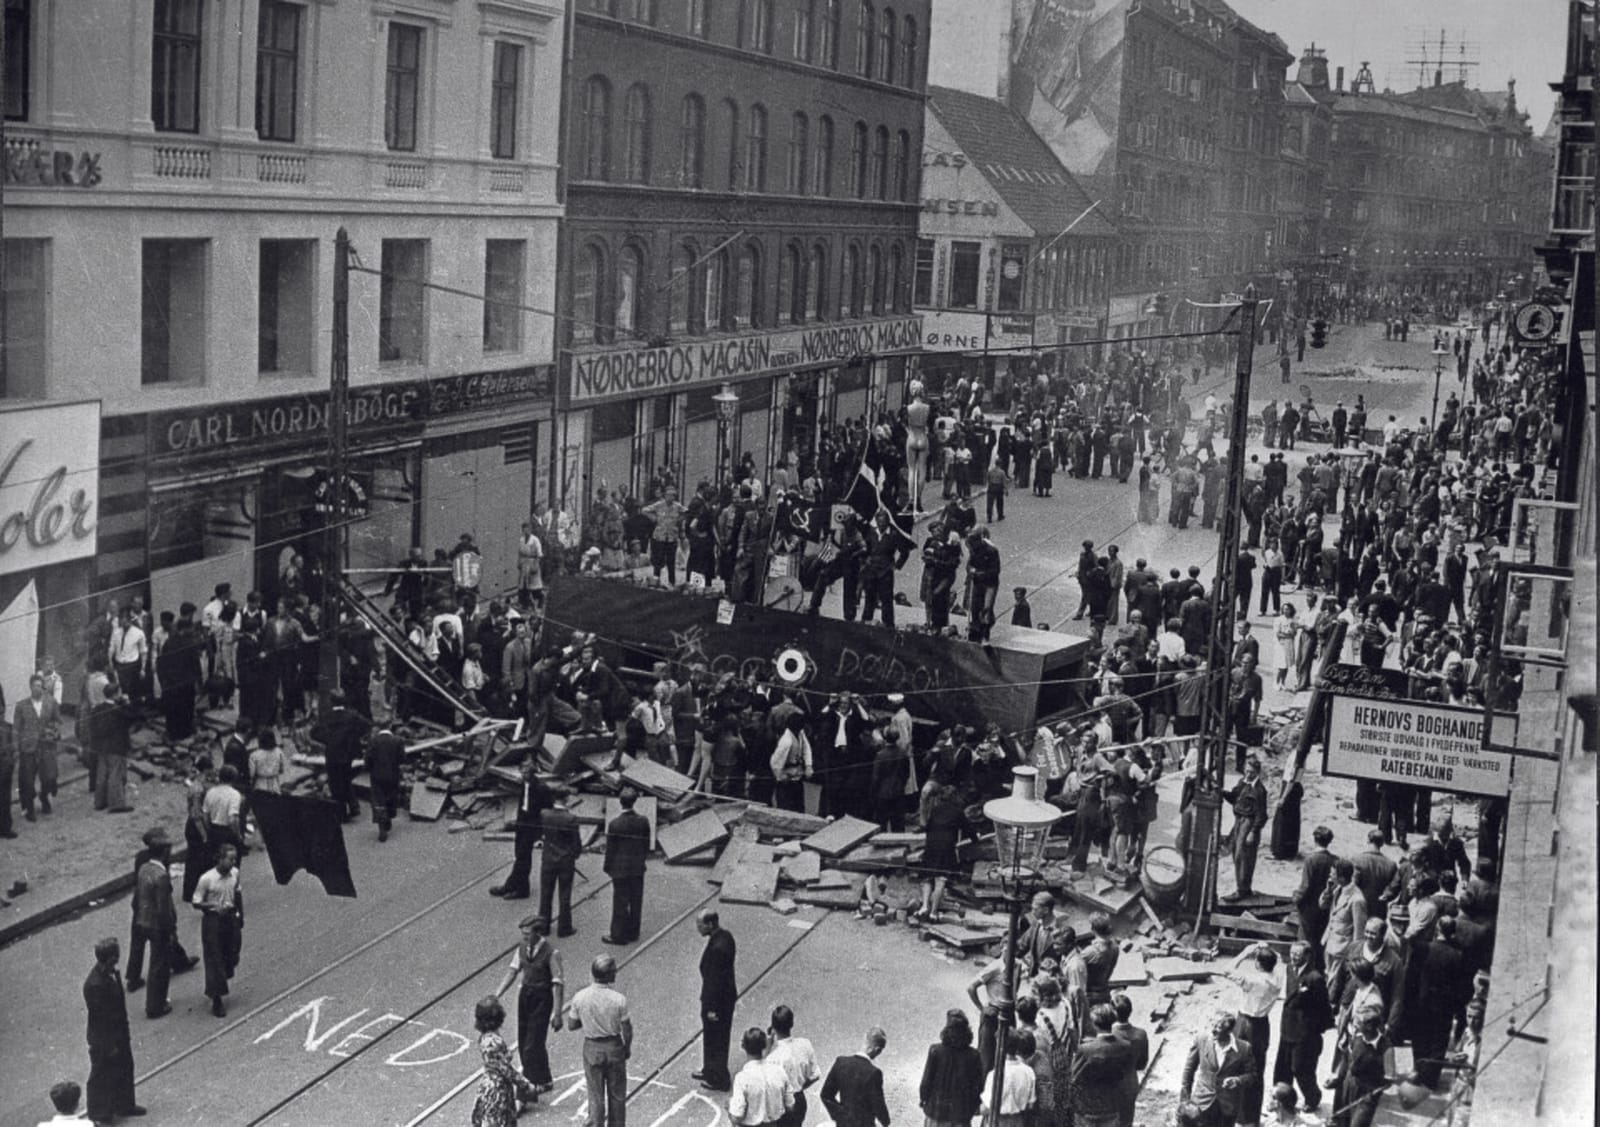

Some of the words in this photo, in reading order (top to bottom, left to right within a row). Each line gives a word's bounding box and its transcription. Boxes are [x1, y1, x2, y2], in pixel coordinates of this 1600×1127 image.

[801, 325, 874, 363] NØRREBROS
[876, 319, 922, 350] MAGASIN
[576, 346, 693, 396] NØRREBROS
[700, 337, 770, 380] MAGASIN
[167, 414, 238, 449] CARL
[0, 438, 97, 554] oler
[1354, 706, 1412, 731] HERNOVS
[1416, 714, 1486, 741] BOGHANDE
[1424, 752, 1439, 763] PAA
[1431, 738, 1480, 755] FYLDEPENNE
[1380, 758, 1453, 782] RATEBETALING
[253, 995, 472, 1067] NED
